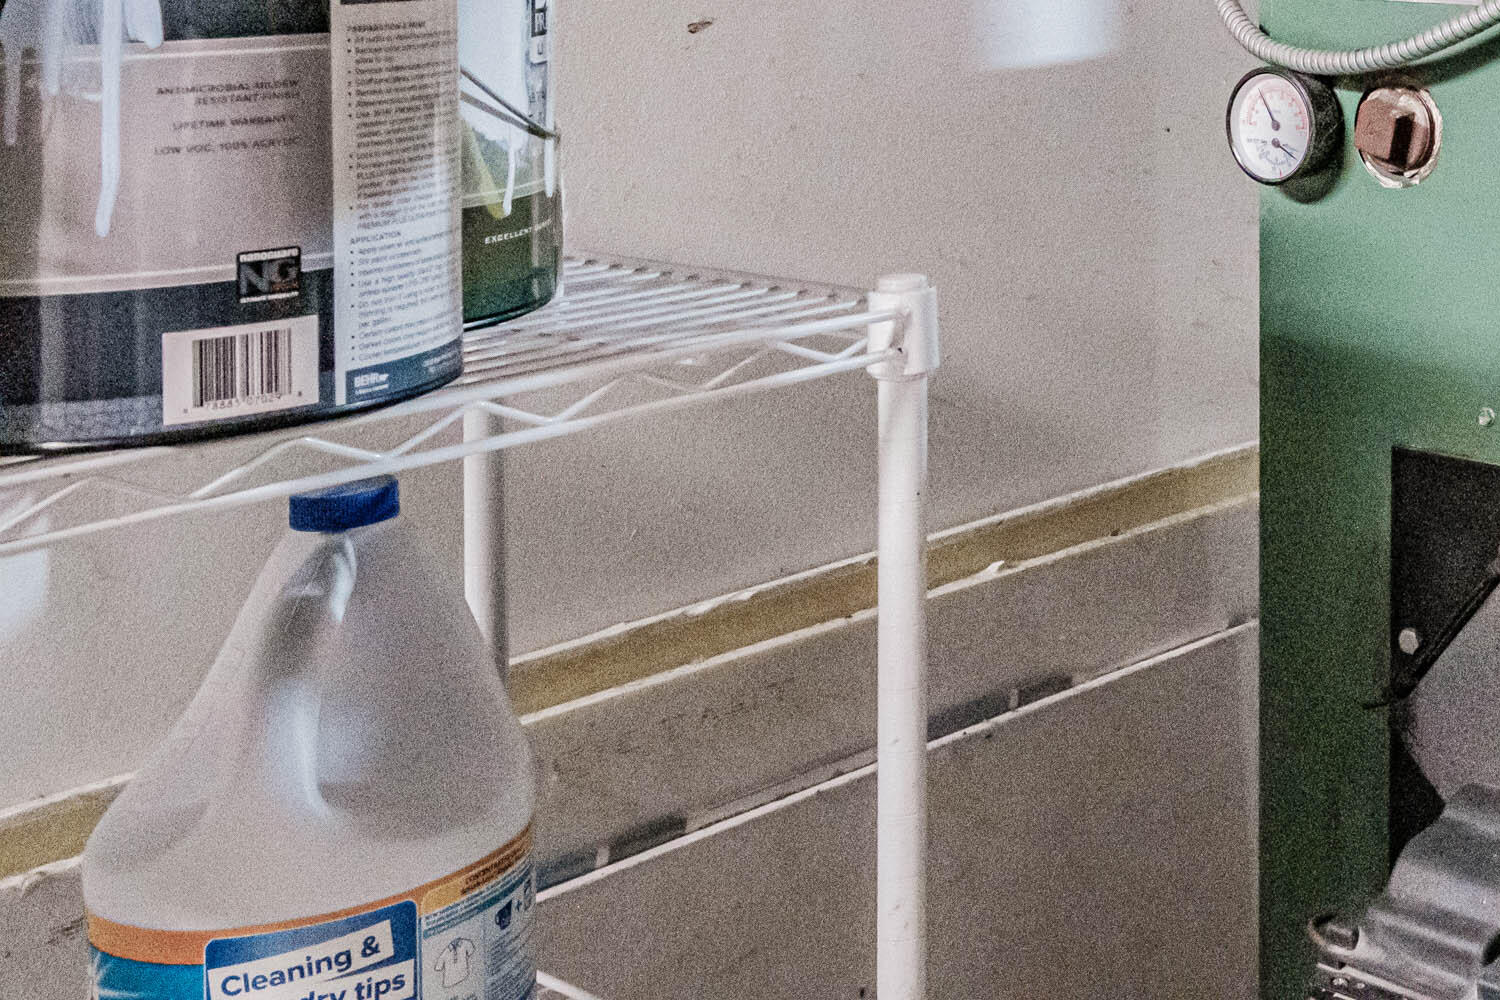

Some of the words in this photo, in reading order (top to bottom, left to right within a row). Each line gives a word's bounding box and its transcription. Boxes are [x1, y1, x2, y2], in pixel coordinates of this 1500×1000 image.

[484, 226, 533, 245] EXCELLENT
[220, 948, 353, 997] Cleaning
[360, 935, 381, 959] &
[353, 973, 406, 1000] tips
